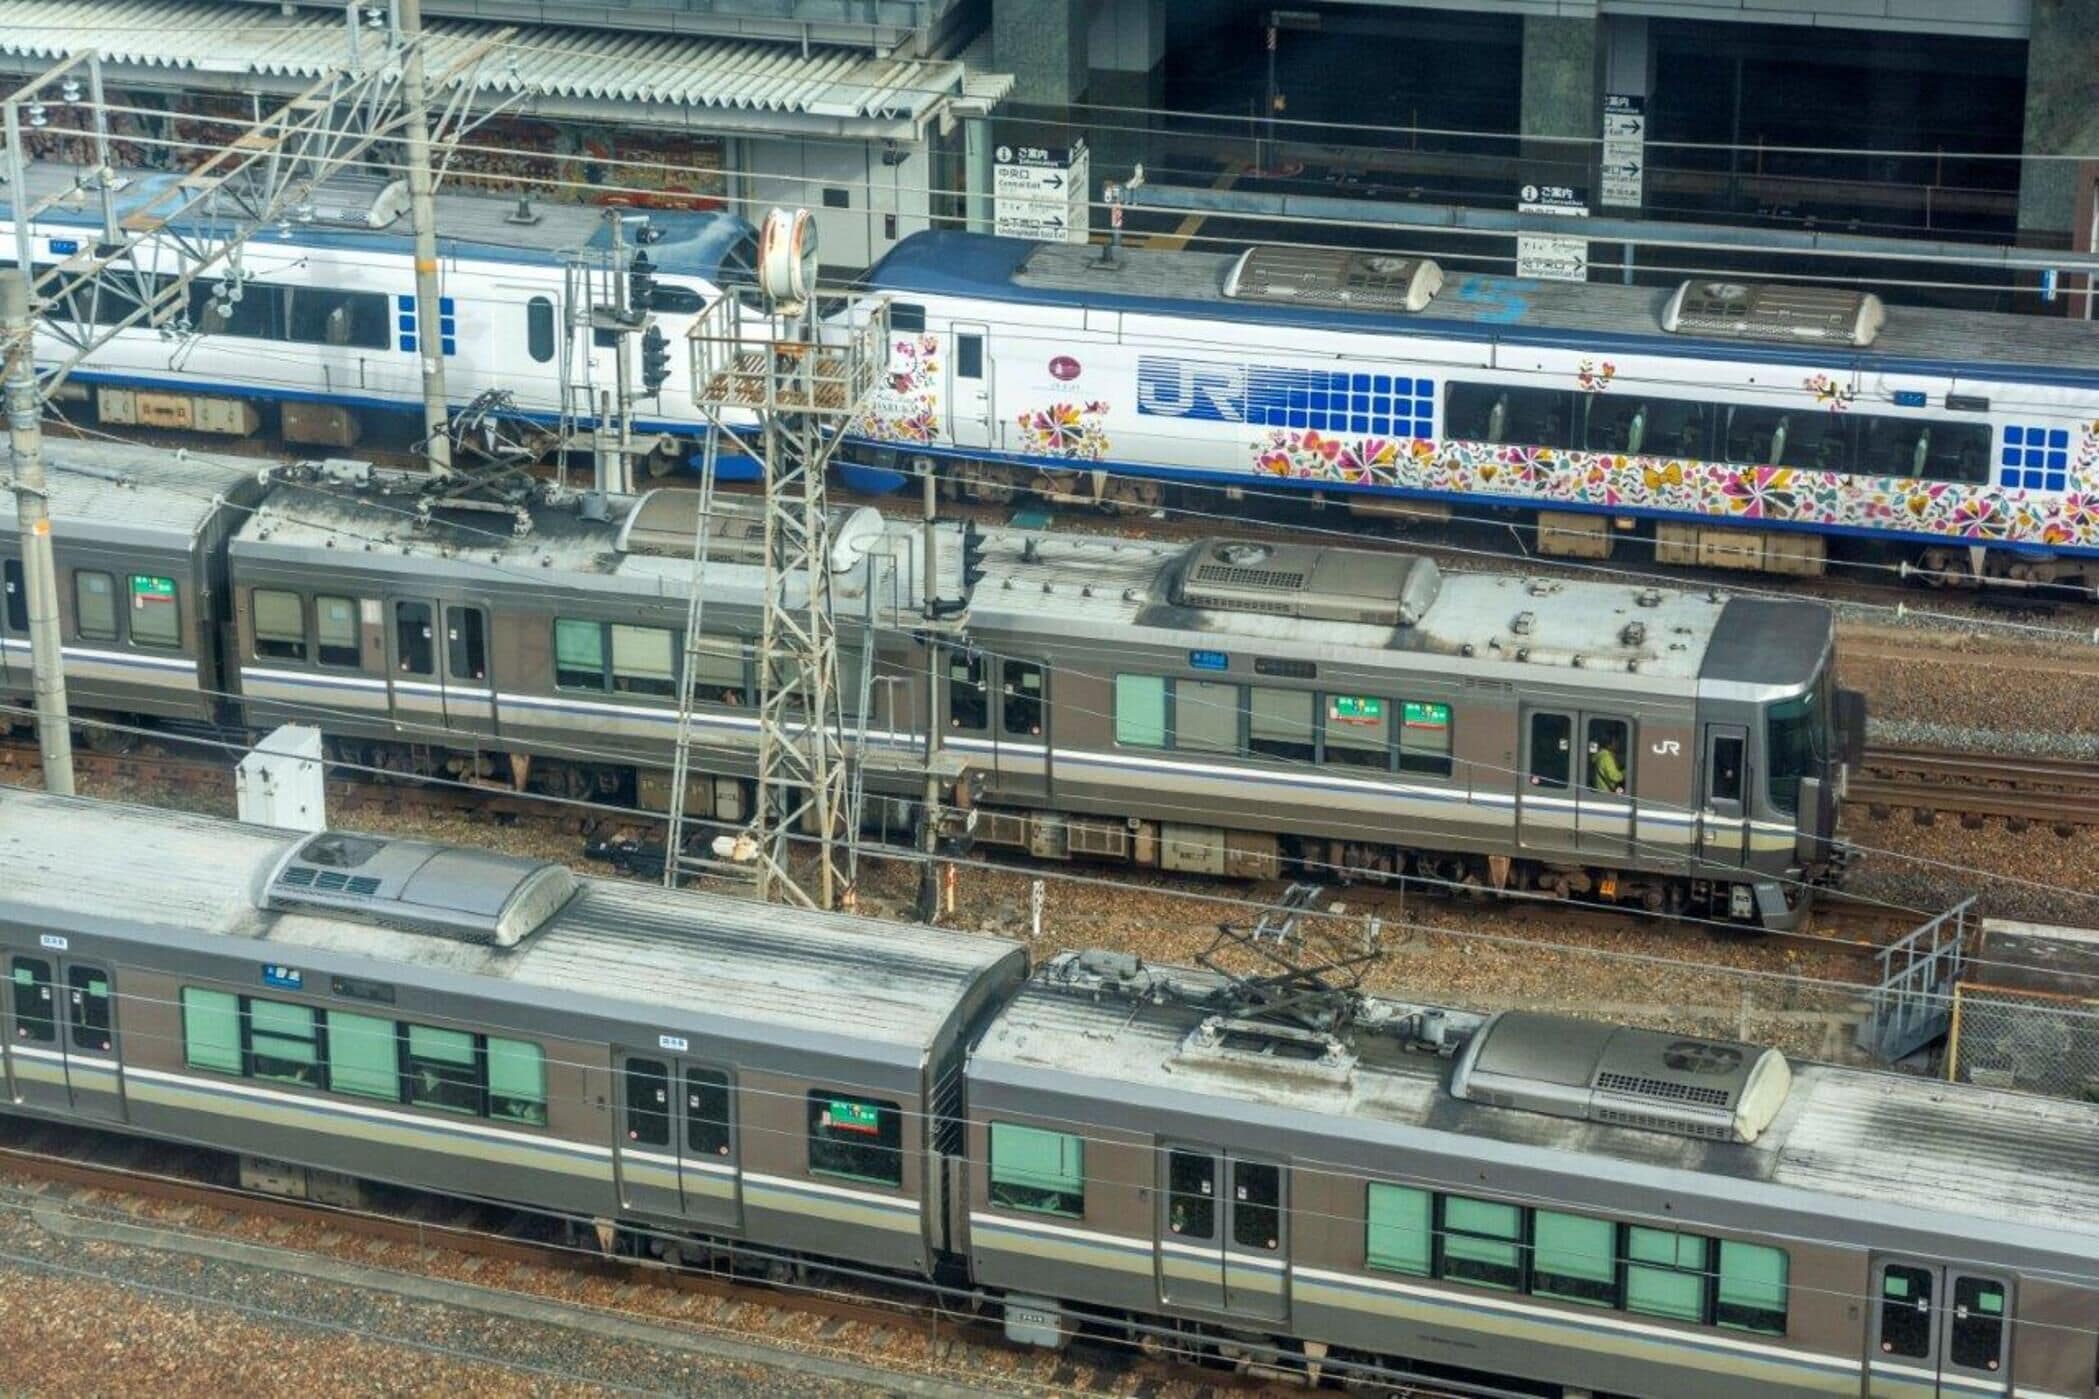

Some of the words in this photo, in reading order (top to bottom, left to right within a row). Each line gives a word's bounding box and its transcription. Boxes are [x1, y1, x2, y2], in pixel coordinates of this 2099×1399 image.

[1018, 147, 1048, 161] ご案内
[998, 168, 1030, 180] 中央口
[1541, 186, 1573, 199] ご案内
[1138, 358, 1245, 421] JR
[1652, 740, 1680, 756] JR
